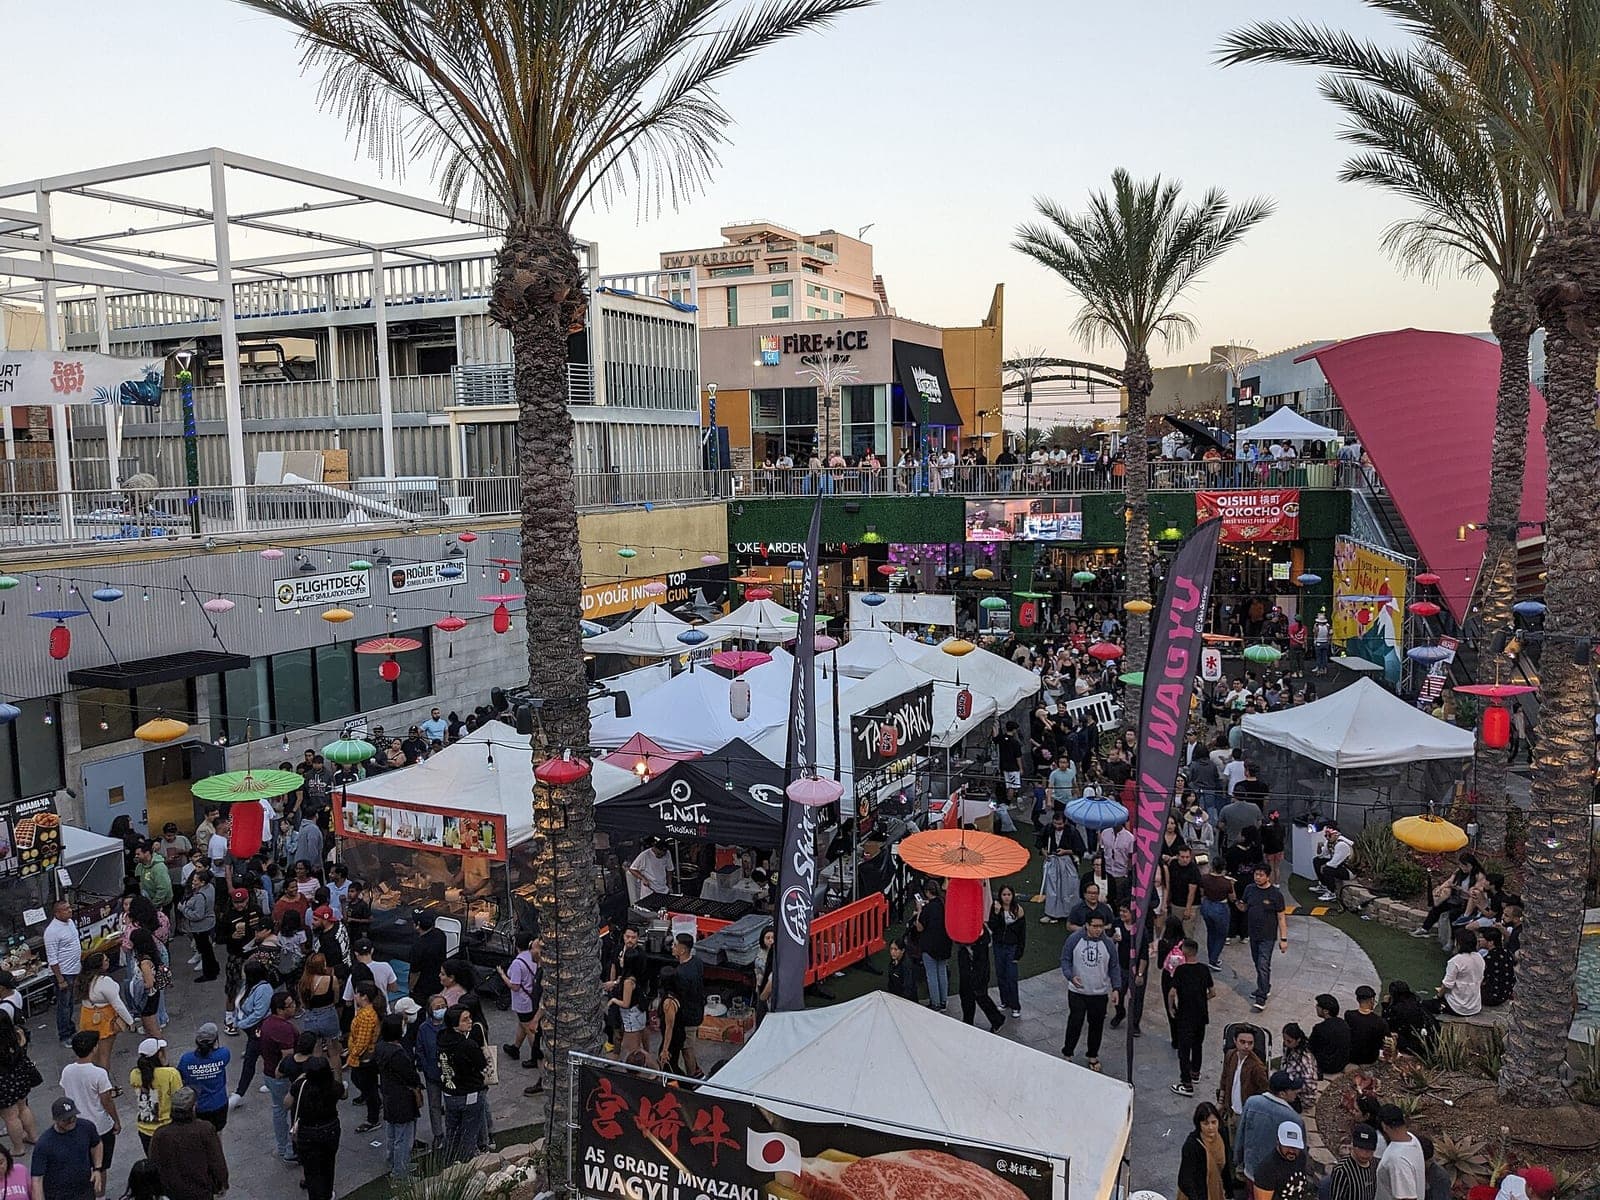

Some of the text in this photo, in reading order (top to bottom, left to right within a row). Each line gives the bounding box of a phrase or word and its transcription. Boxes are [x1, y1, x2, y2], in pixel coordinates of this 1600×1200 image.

[664, 248, 762, 269] JW MARRIOTT
[53, 361, 84, 377] Eat
[50, 375, 85, 395] Up!
[1216, 495, 1257, 506] OISHII
[1217, 506, 1281, 517] YOKOCHO
[735, 542, 806, 554] OKE ARDEN
[406, 565, 433, 580] ROGUE
[668, 572, 687, 586] TOP
[295, 574, 366, 595] FLIGHTDECK
[406, 577, 436, 587] SIMULATION
[297, 587, 366, 602] FLIGHT SIMULATION CENTER
[596, 588, 629, 608] YOUR
[667, 587, 689, 603] GUN
[1147, 575, 1201, 757] WAGYU
[345, 717, 367, 728] NOTICE
[858, 695, 931, 761] TAOYAKI
[192, 1067, 220, 1075] DODGERS
[199, 1060, 224, 1070] ANGELES
[584, 1146, 759, 1200] A5 GRADE MIYAZAKI
[584, 1164, 680, 1200] WAGYU
